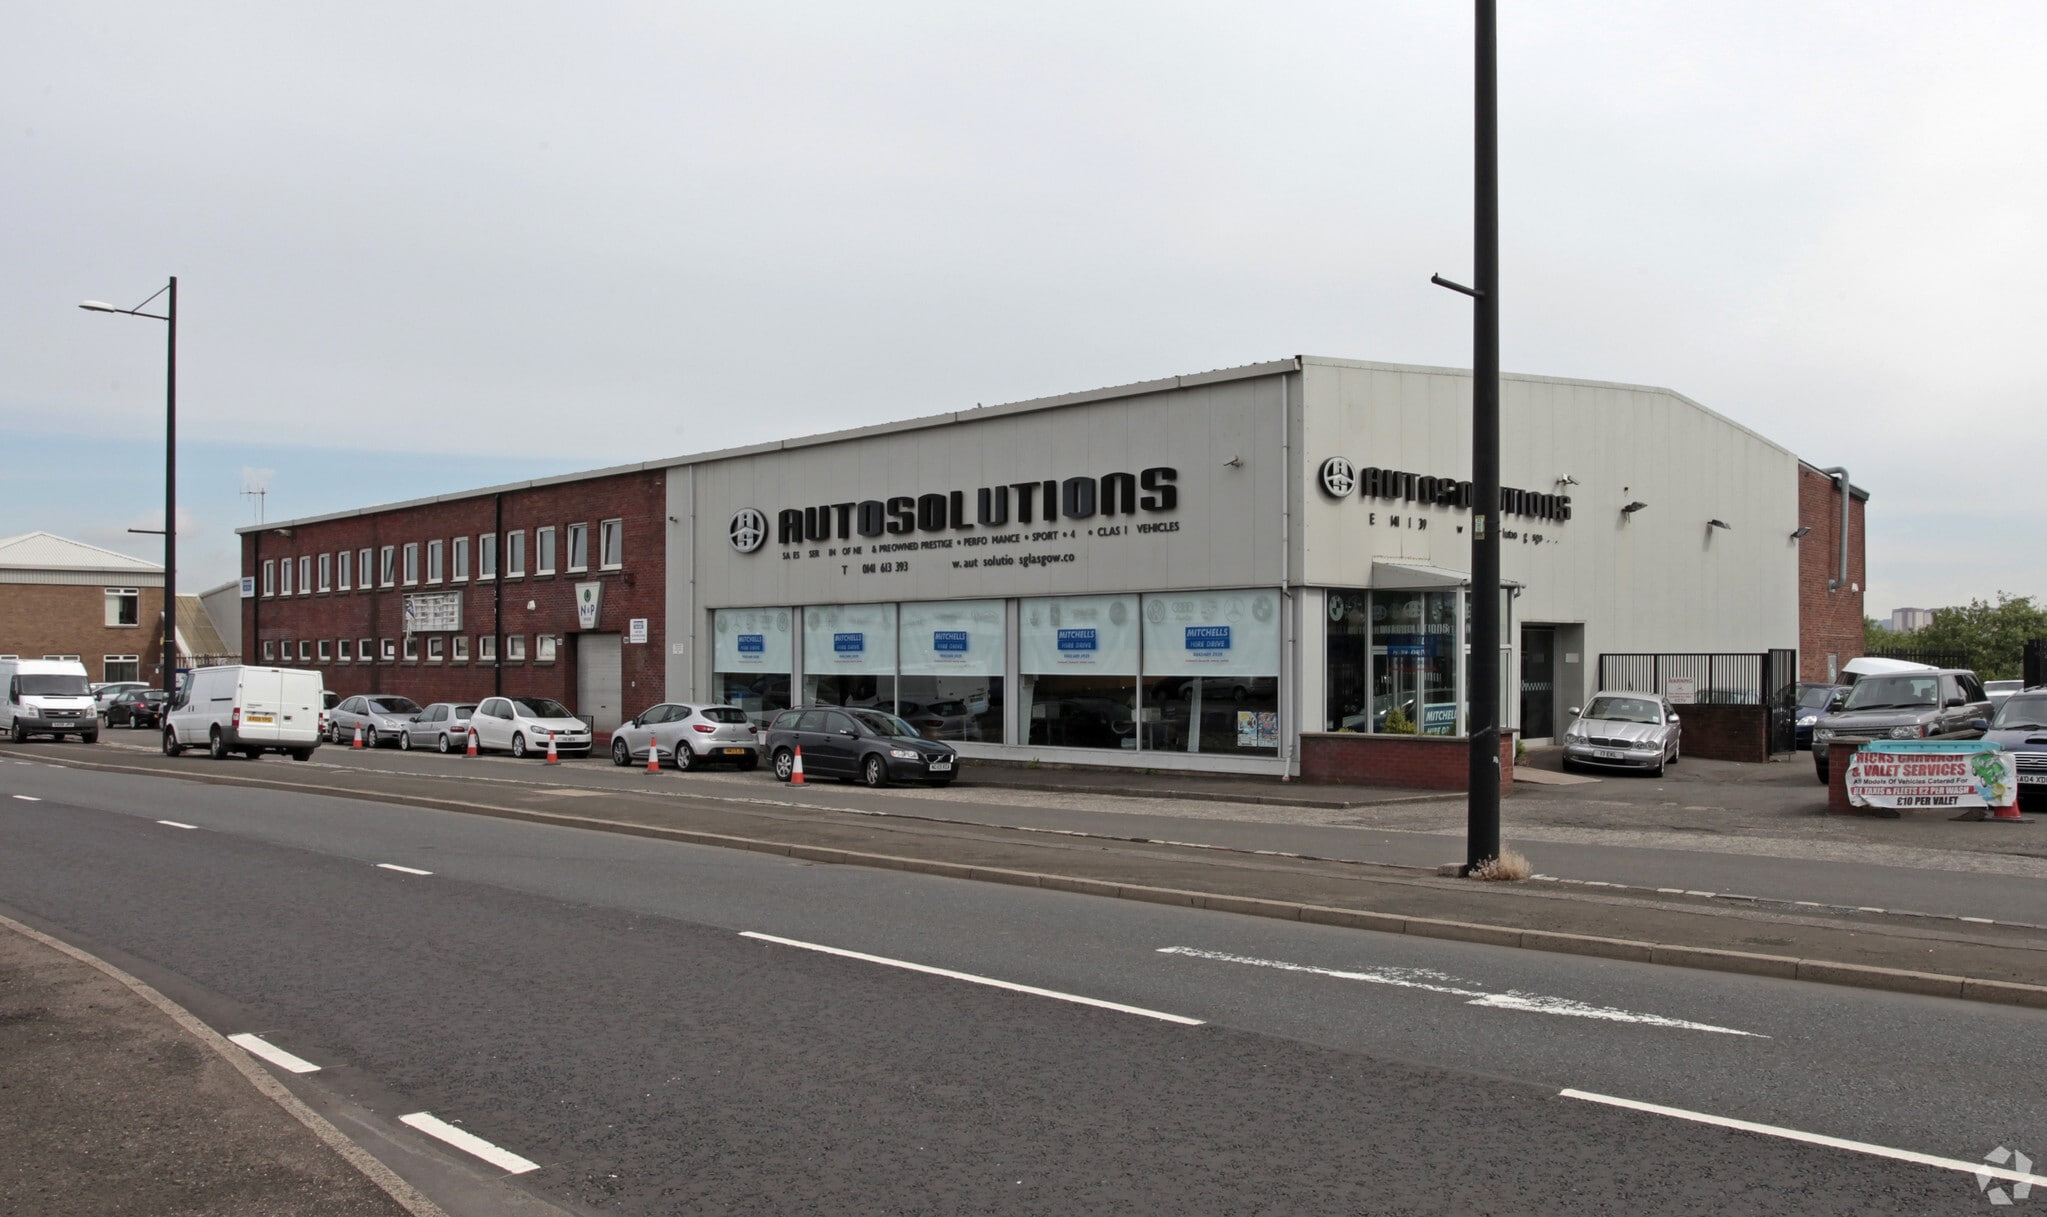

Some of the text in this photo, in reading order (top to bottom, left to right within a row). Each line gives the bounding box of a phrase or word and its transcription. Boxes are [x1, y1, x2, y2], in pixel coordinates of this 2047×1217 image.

[1361, 467, 1571, 520] AUTOSOTIONS
[777, 467, 1177, 544] AUTOSOLUTIONS
[920, 538, 953, 551] PRESTIGE
[1032, 530, 1059, 542] SPORT
[1136, 521, 1180, 535] VEHICLES
[880, 561, 893, 573] 613
[1058, 630, 1096, 640] MITCHELLS
[1186, 627, 1229, 637] MITCHELLS
[1852, 763, 1966, 777] & VALET SERVICES
[1864, 787, 1885, 795] TAXIS
[1886, 787, 1893, 795] &
[1893, 786, 1917, 795] FLEETS
[1930, 786, 1944, 794] PER
[1945, 785, 1969, 794] WASH
[1896, 795, 1958, 806] £10 PER VALET
